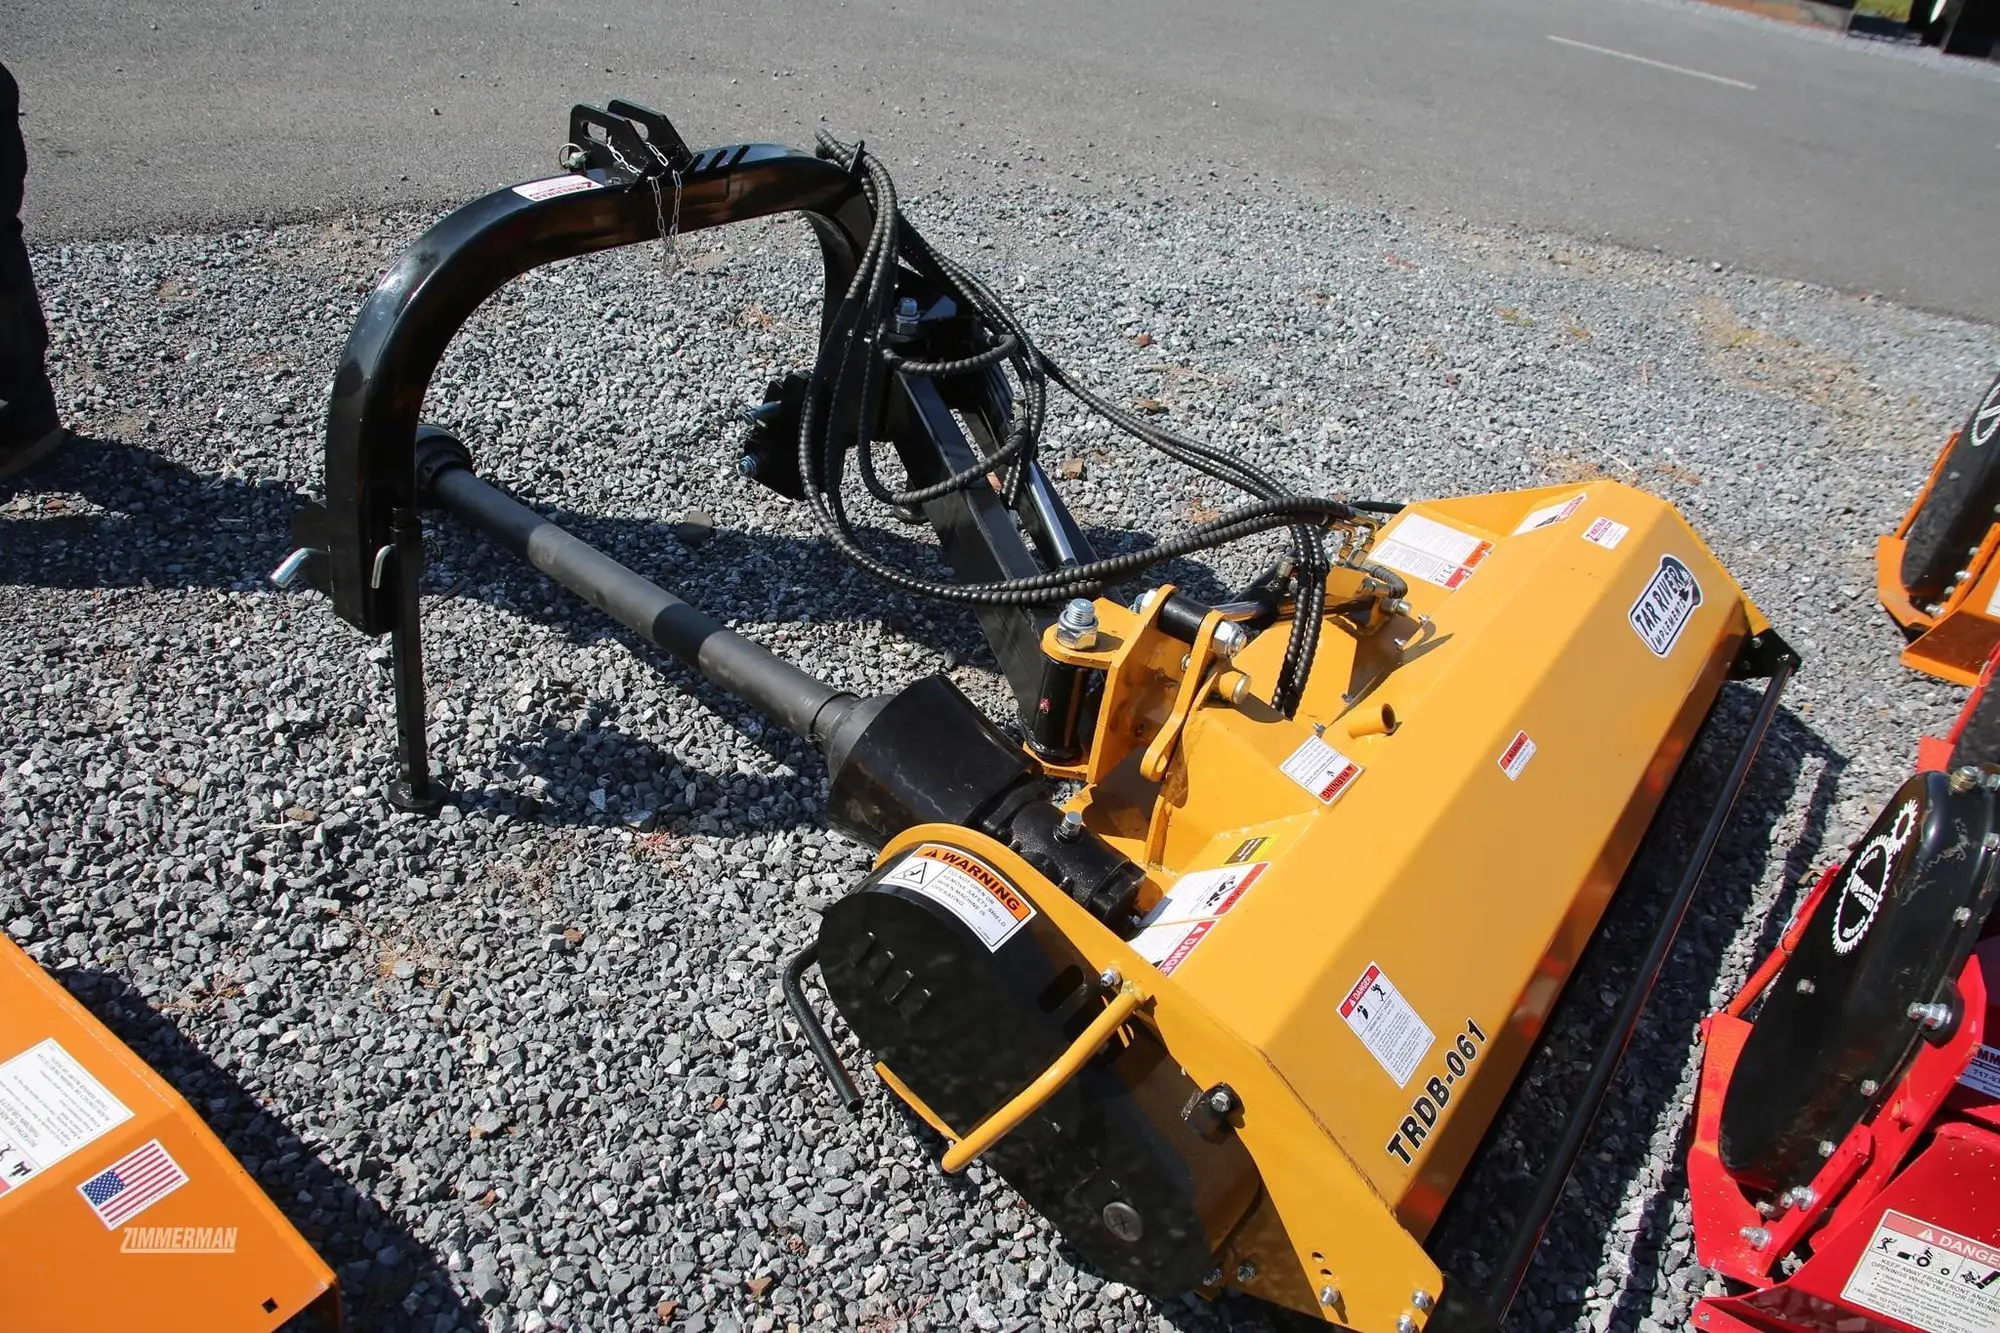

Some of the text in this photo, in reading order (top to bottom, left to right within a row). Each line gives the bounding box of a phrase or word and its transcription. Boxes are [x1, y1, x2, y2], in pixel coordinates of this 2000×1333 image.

[1634, 567, 1683, 637] TAR RIVER
[1650, 598, 1686, 651] IMPLEMENTS
[1322, 769, 1351, 798] WARNING
[937, 879, 955, 891] WHEN
[955, 889, 980, 911] MACHINE
[942, 852, 1020, 911] WARNING
[943, 874, 1007, 927] REMOVE SAFETY SHIELD
[958, 875, 970, 884] NOT
[970, 883, 986, 898] OPEN
[985, 896, 995, 905] OR
[1353, 975, 1373, 1000] DANGER
[1387, 1017, 1487, 1165] TRDB-061
[1939, 1237, 2000, 1265] DANGE
[1871, 1262, 1907, 1278] OPENINGS
[1909, 1276, 1931, 1287] WHEN
[1932, 1284, 1967, 1301] TRACTOR
[1881, 1259, 1900, 1269] KEEP
[1902, 1267, 1921, 1277] AWAY
[1922, 1275, 1944, 1285] FROM
[1944, 1283, 1969, 1295] FRONT
[1971, 1293, 1988, 1302] AND
